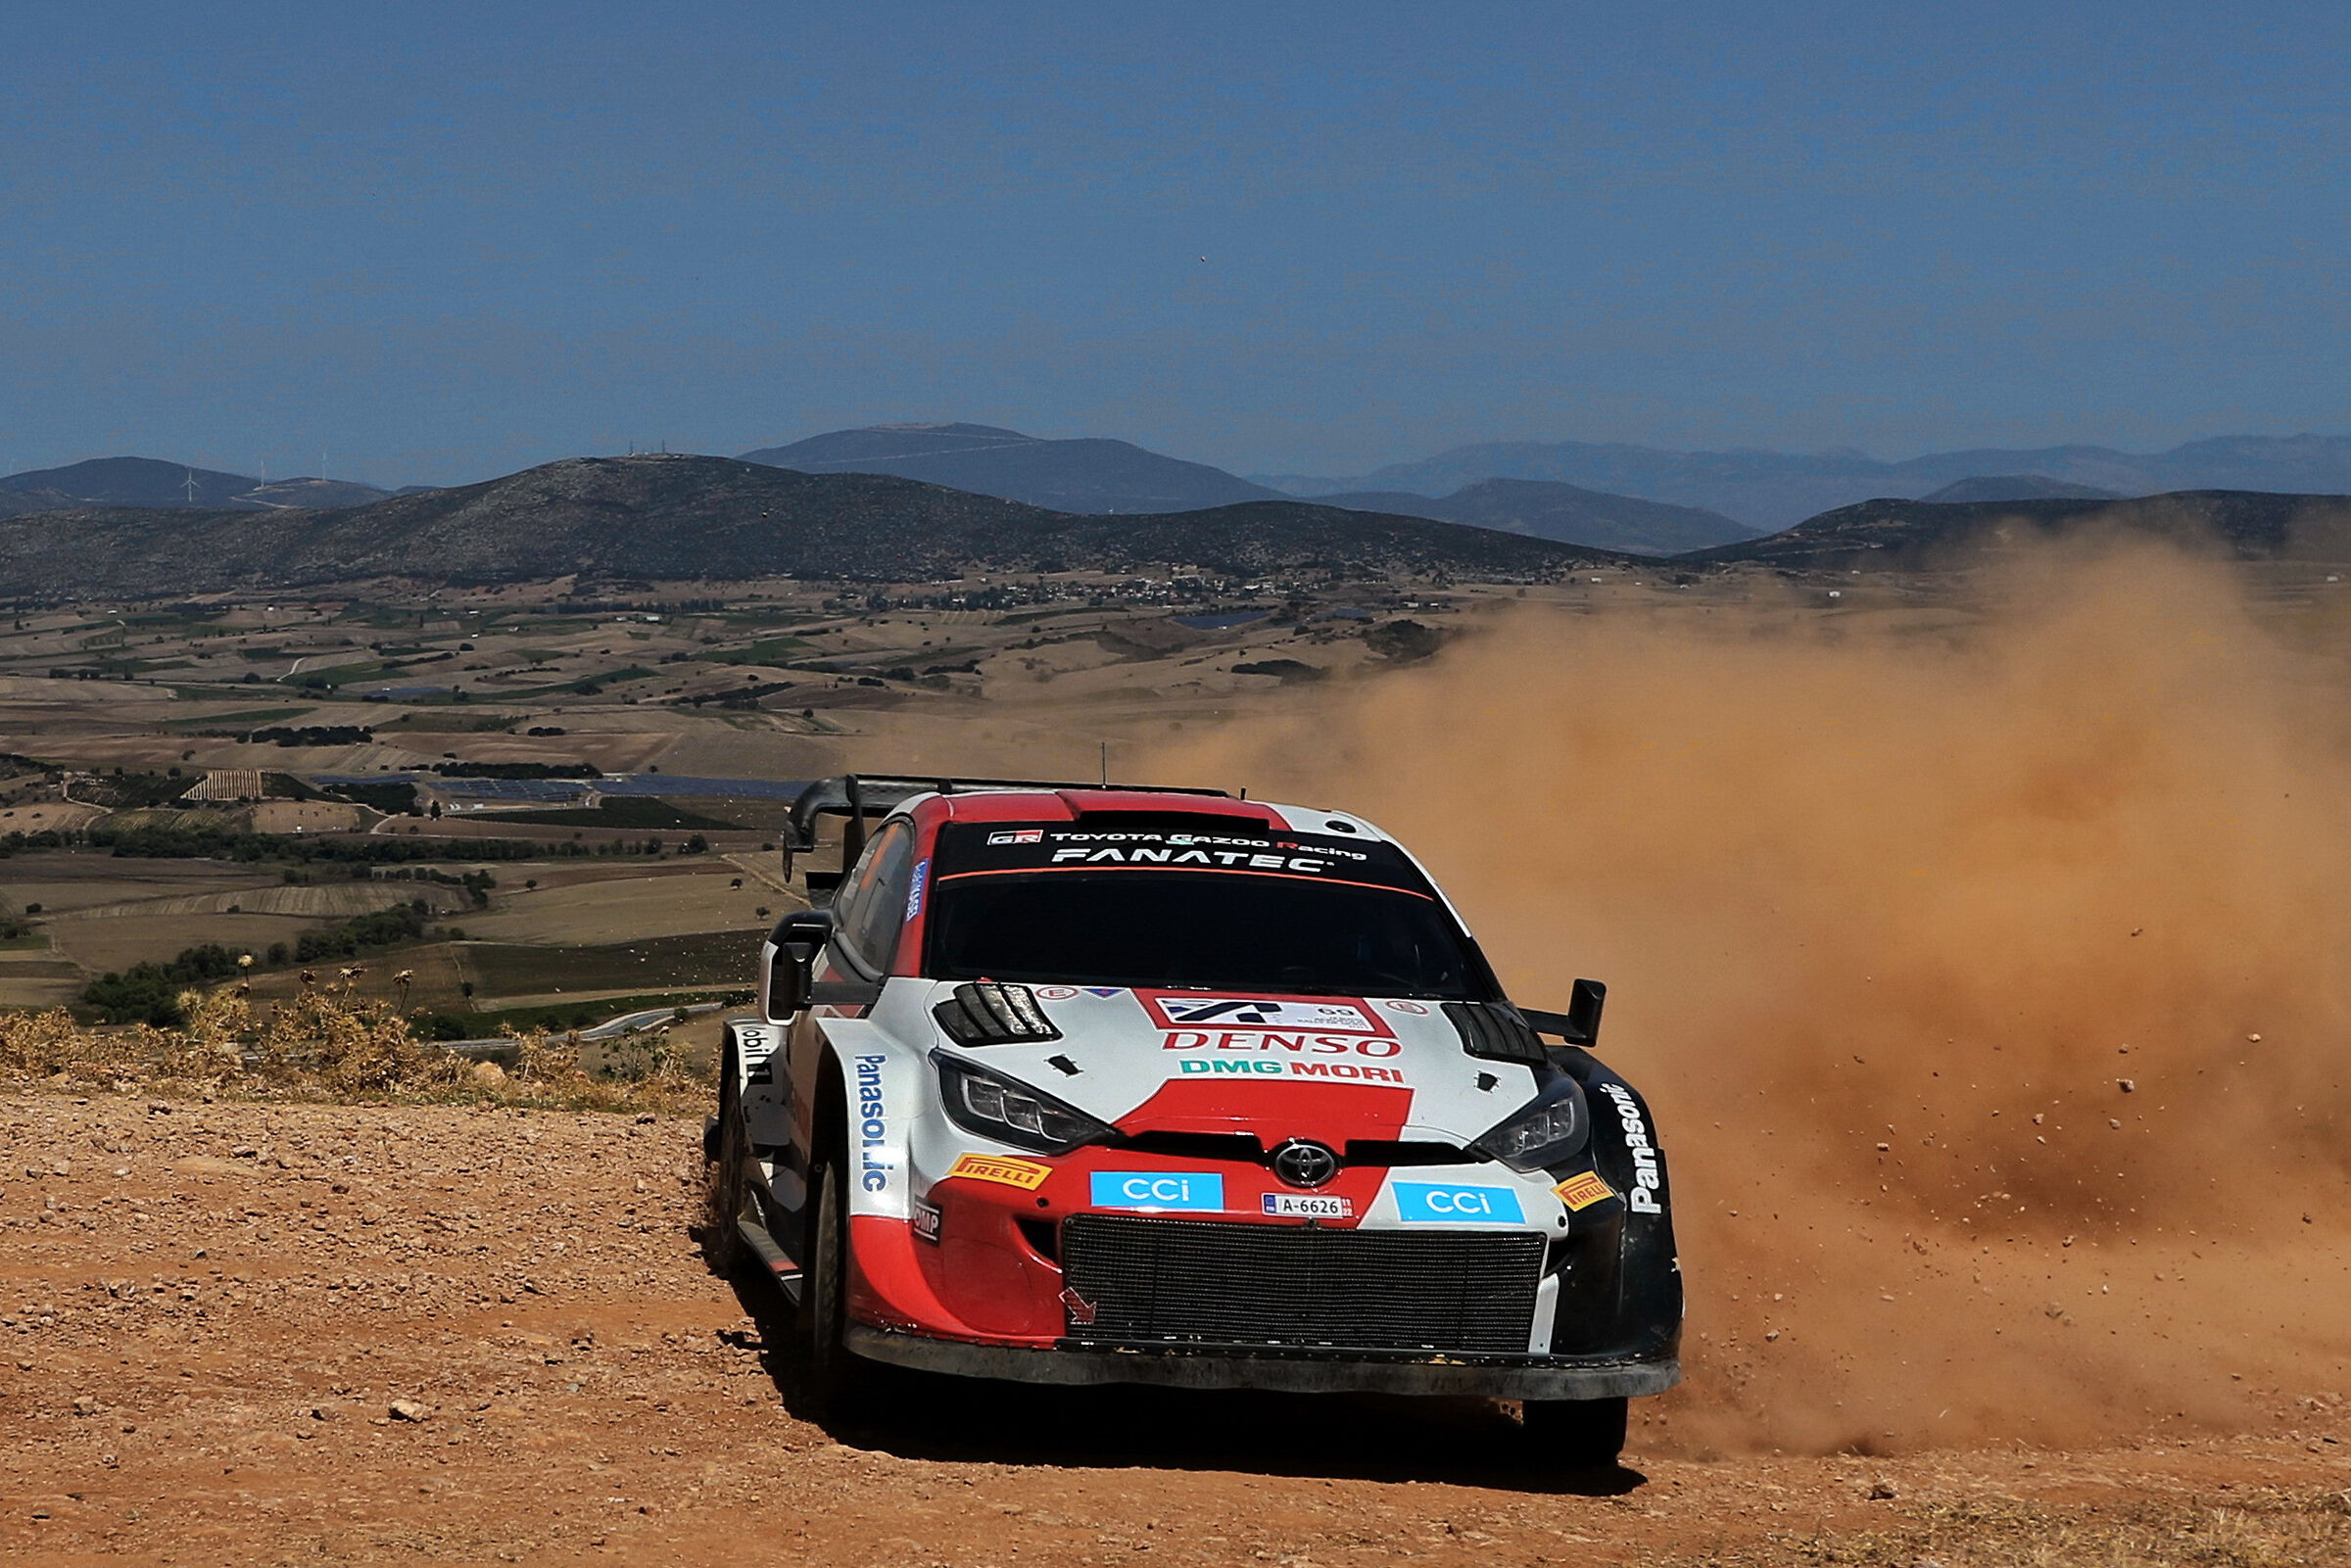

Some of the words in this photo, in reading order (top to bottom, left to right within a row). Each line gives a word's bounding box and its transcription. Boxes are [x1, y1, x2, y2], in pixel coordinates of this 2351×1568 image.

[991, 835, 1039, 844] GR
[1051, 848, 1324, 873] FANATEC
[1163, 1032, 1402, 1057] DENSO
[1180, 1060, 1282, 1073] DMG
[1289, 1062, 1404, 1083] MORI
[1599, 1082, 1661, 1214] Panasonic
[956, 1157, 1040, 1183] PIRELLI
[1559, 1176, 1607, 1205] PIRELLI
[1283, 1199, 1338, 1213] A-6626
[915, 1208, 938, 1234] OMP
